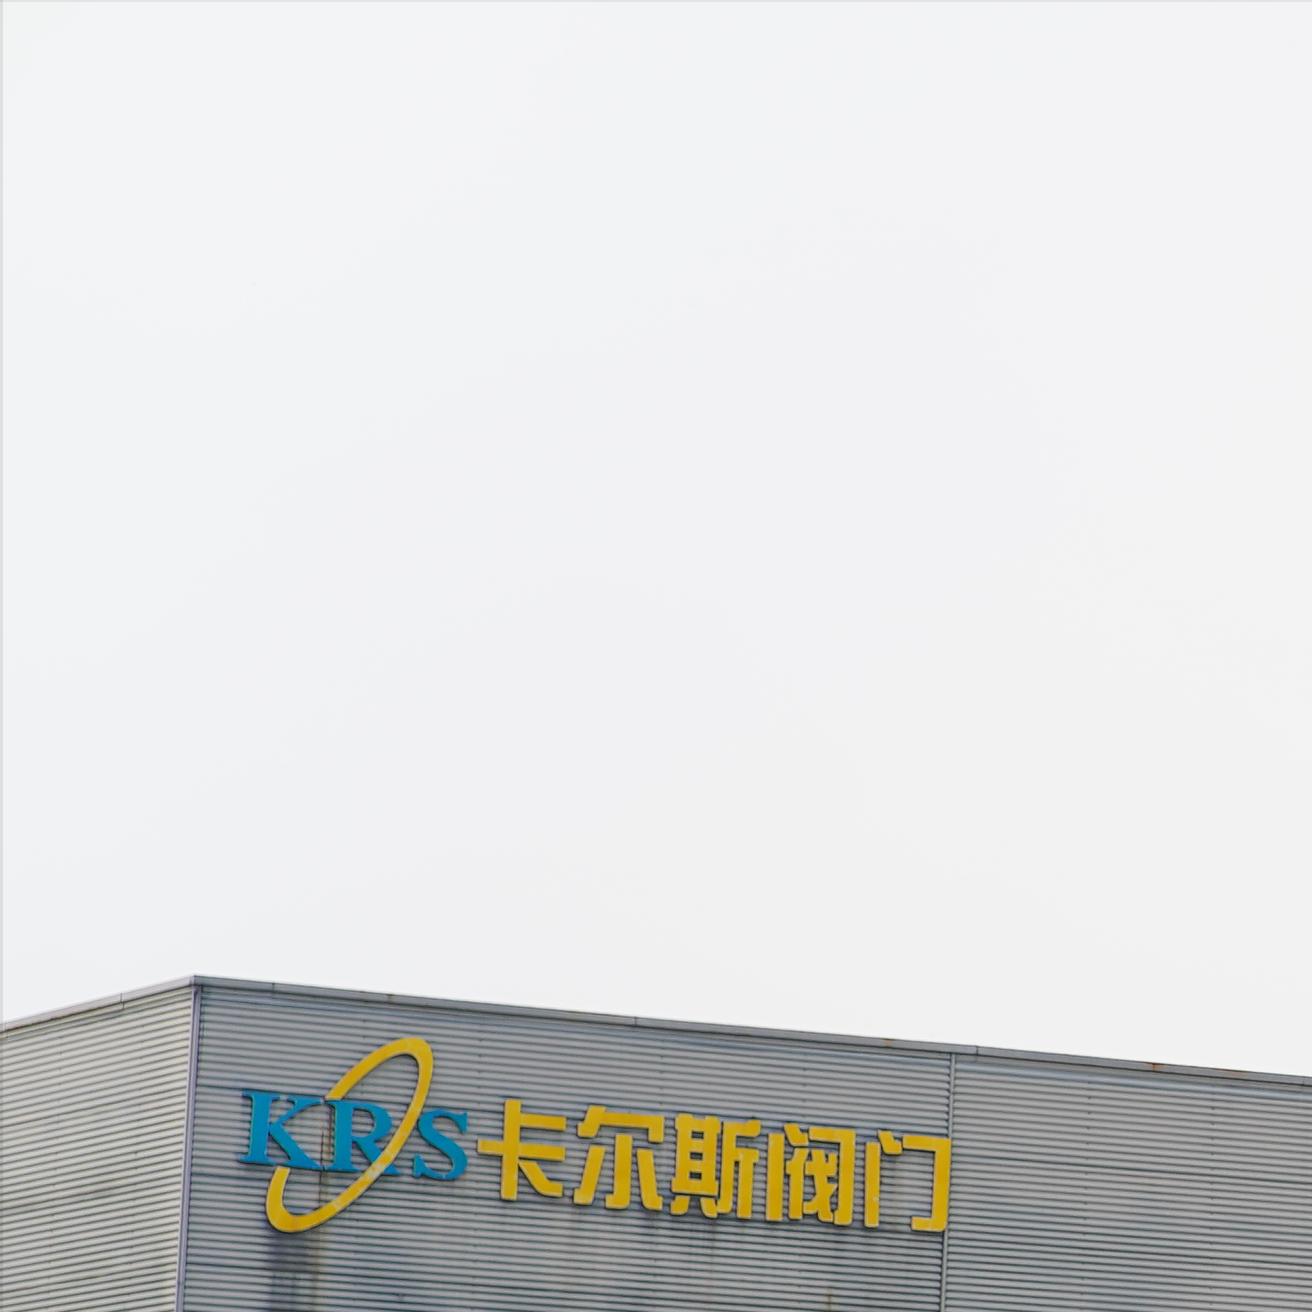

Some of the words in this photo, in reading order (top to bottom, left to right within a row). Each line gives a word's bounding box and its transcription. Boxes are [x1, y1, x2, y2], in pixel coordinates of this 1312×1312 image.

[239, 1088, 470, 1182] KRS
[476, 1099, 952, 1233] 卡尔斯阀门
